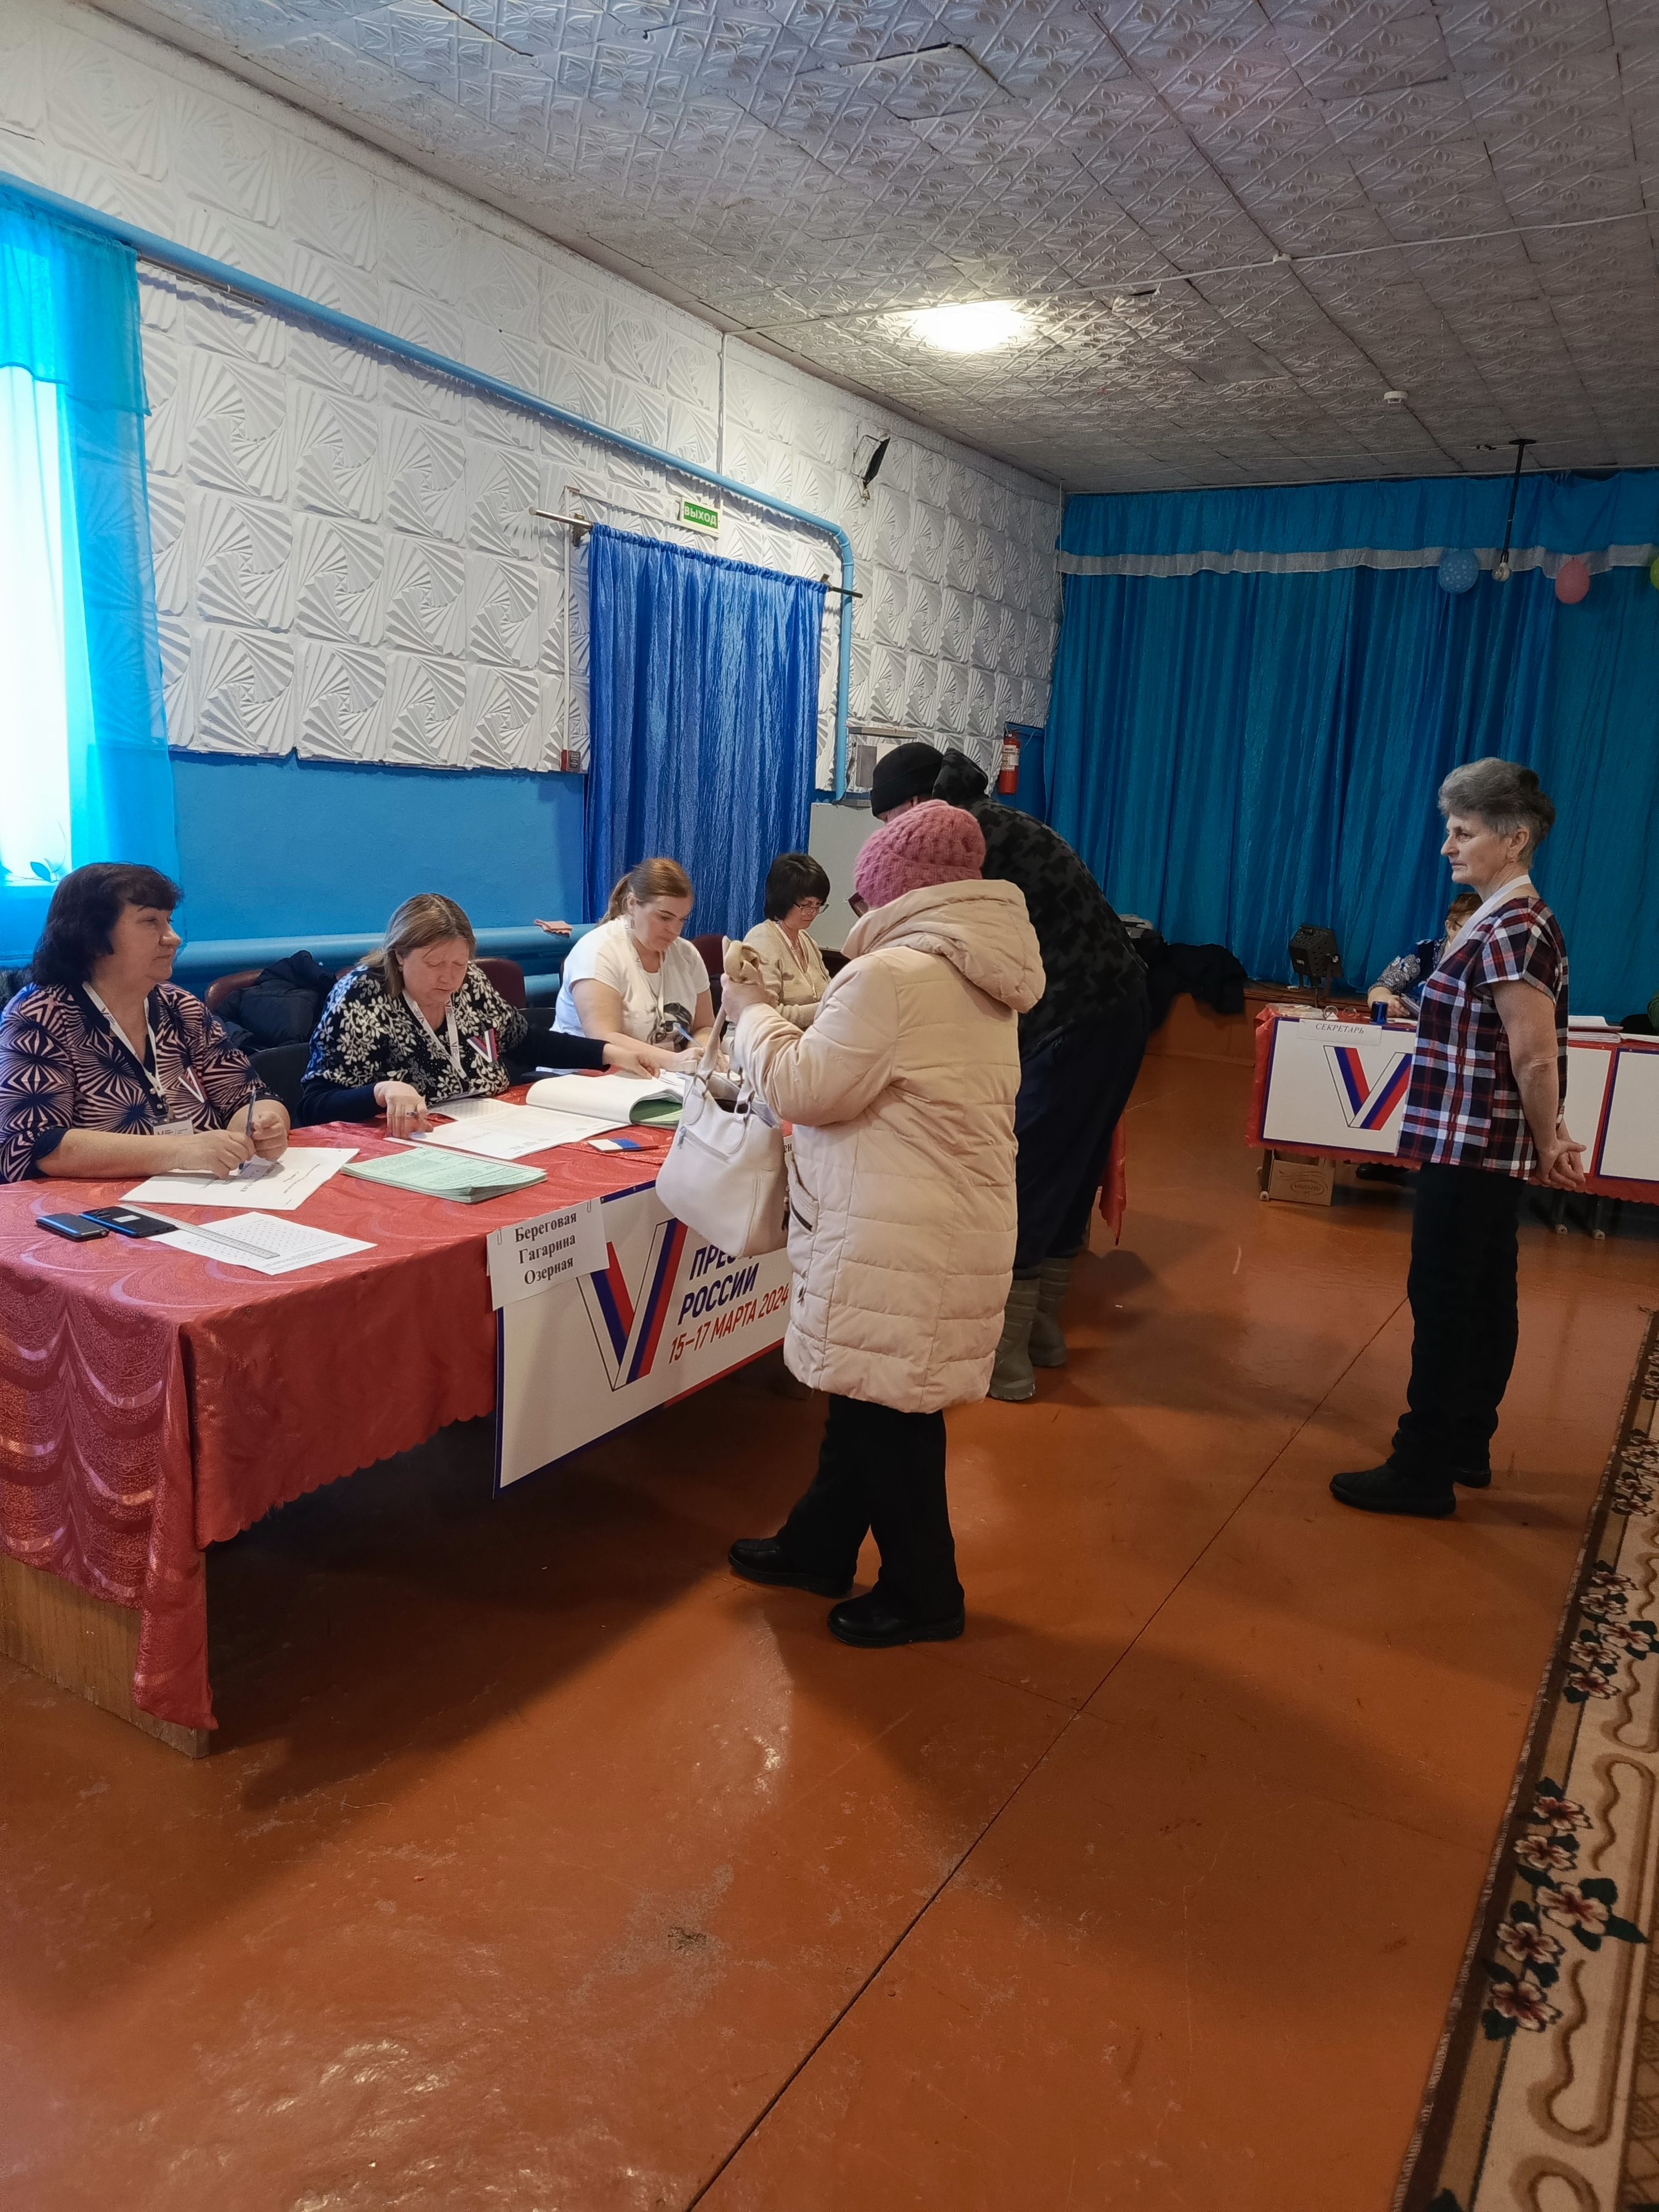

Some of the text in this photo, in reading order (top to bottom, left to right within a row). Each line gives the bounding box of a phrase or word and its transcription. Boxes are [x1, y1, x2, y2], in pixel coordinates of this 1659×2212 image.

[685, 506, 717, 527] ВЫХОД
[1316, 1023, 1364, 1034] СЕКРЕТАРЬ
[515, 1212, 577, 1243] Береговая
[518, 1235, 576, 1265] Гагарина
[524, 1257, 574, 1285] Озерная
[677, 1262, 760, 1326] РОССИИ
[710, 1298, 758, 1343] МАРТА
[758, 1282, 789, 1320] 2024
